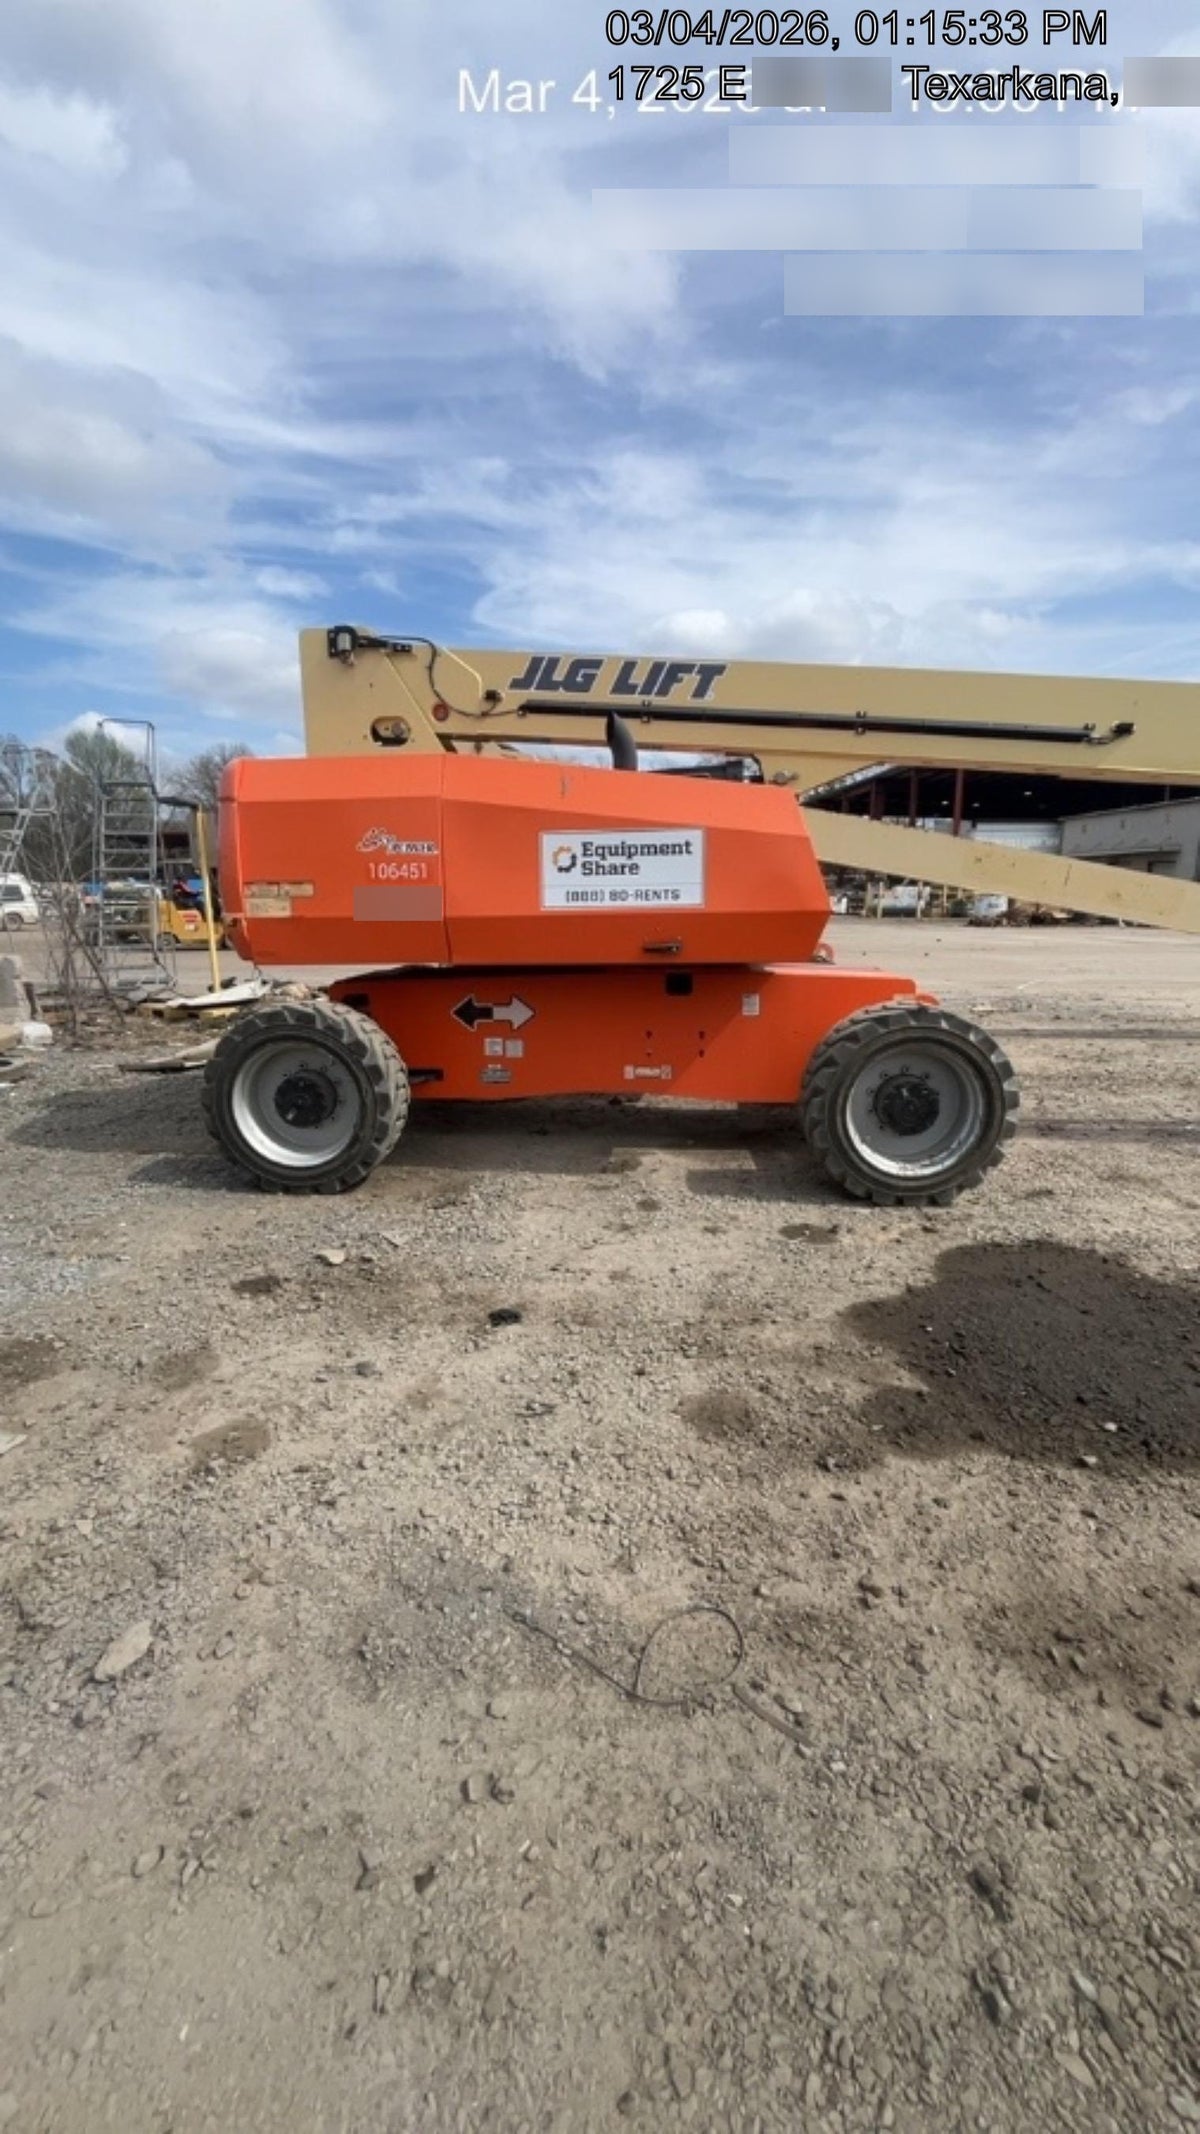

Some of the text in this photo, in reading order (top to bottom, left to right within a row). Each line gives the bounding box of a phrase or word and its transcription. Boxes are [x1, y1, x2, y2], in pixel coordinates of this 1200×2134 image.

[508, 655, 728, 700] JLG LIFT
[580, 840, 693, 861] Equipment
[368, 862, 429, 880] 106451
[581, 861, 641, 876] Share
[608, 888, 681, 903] 80-RENTS
